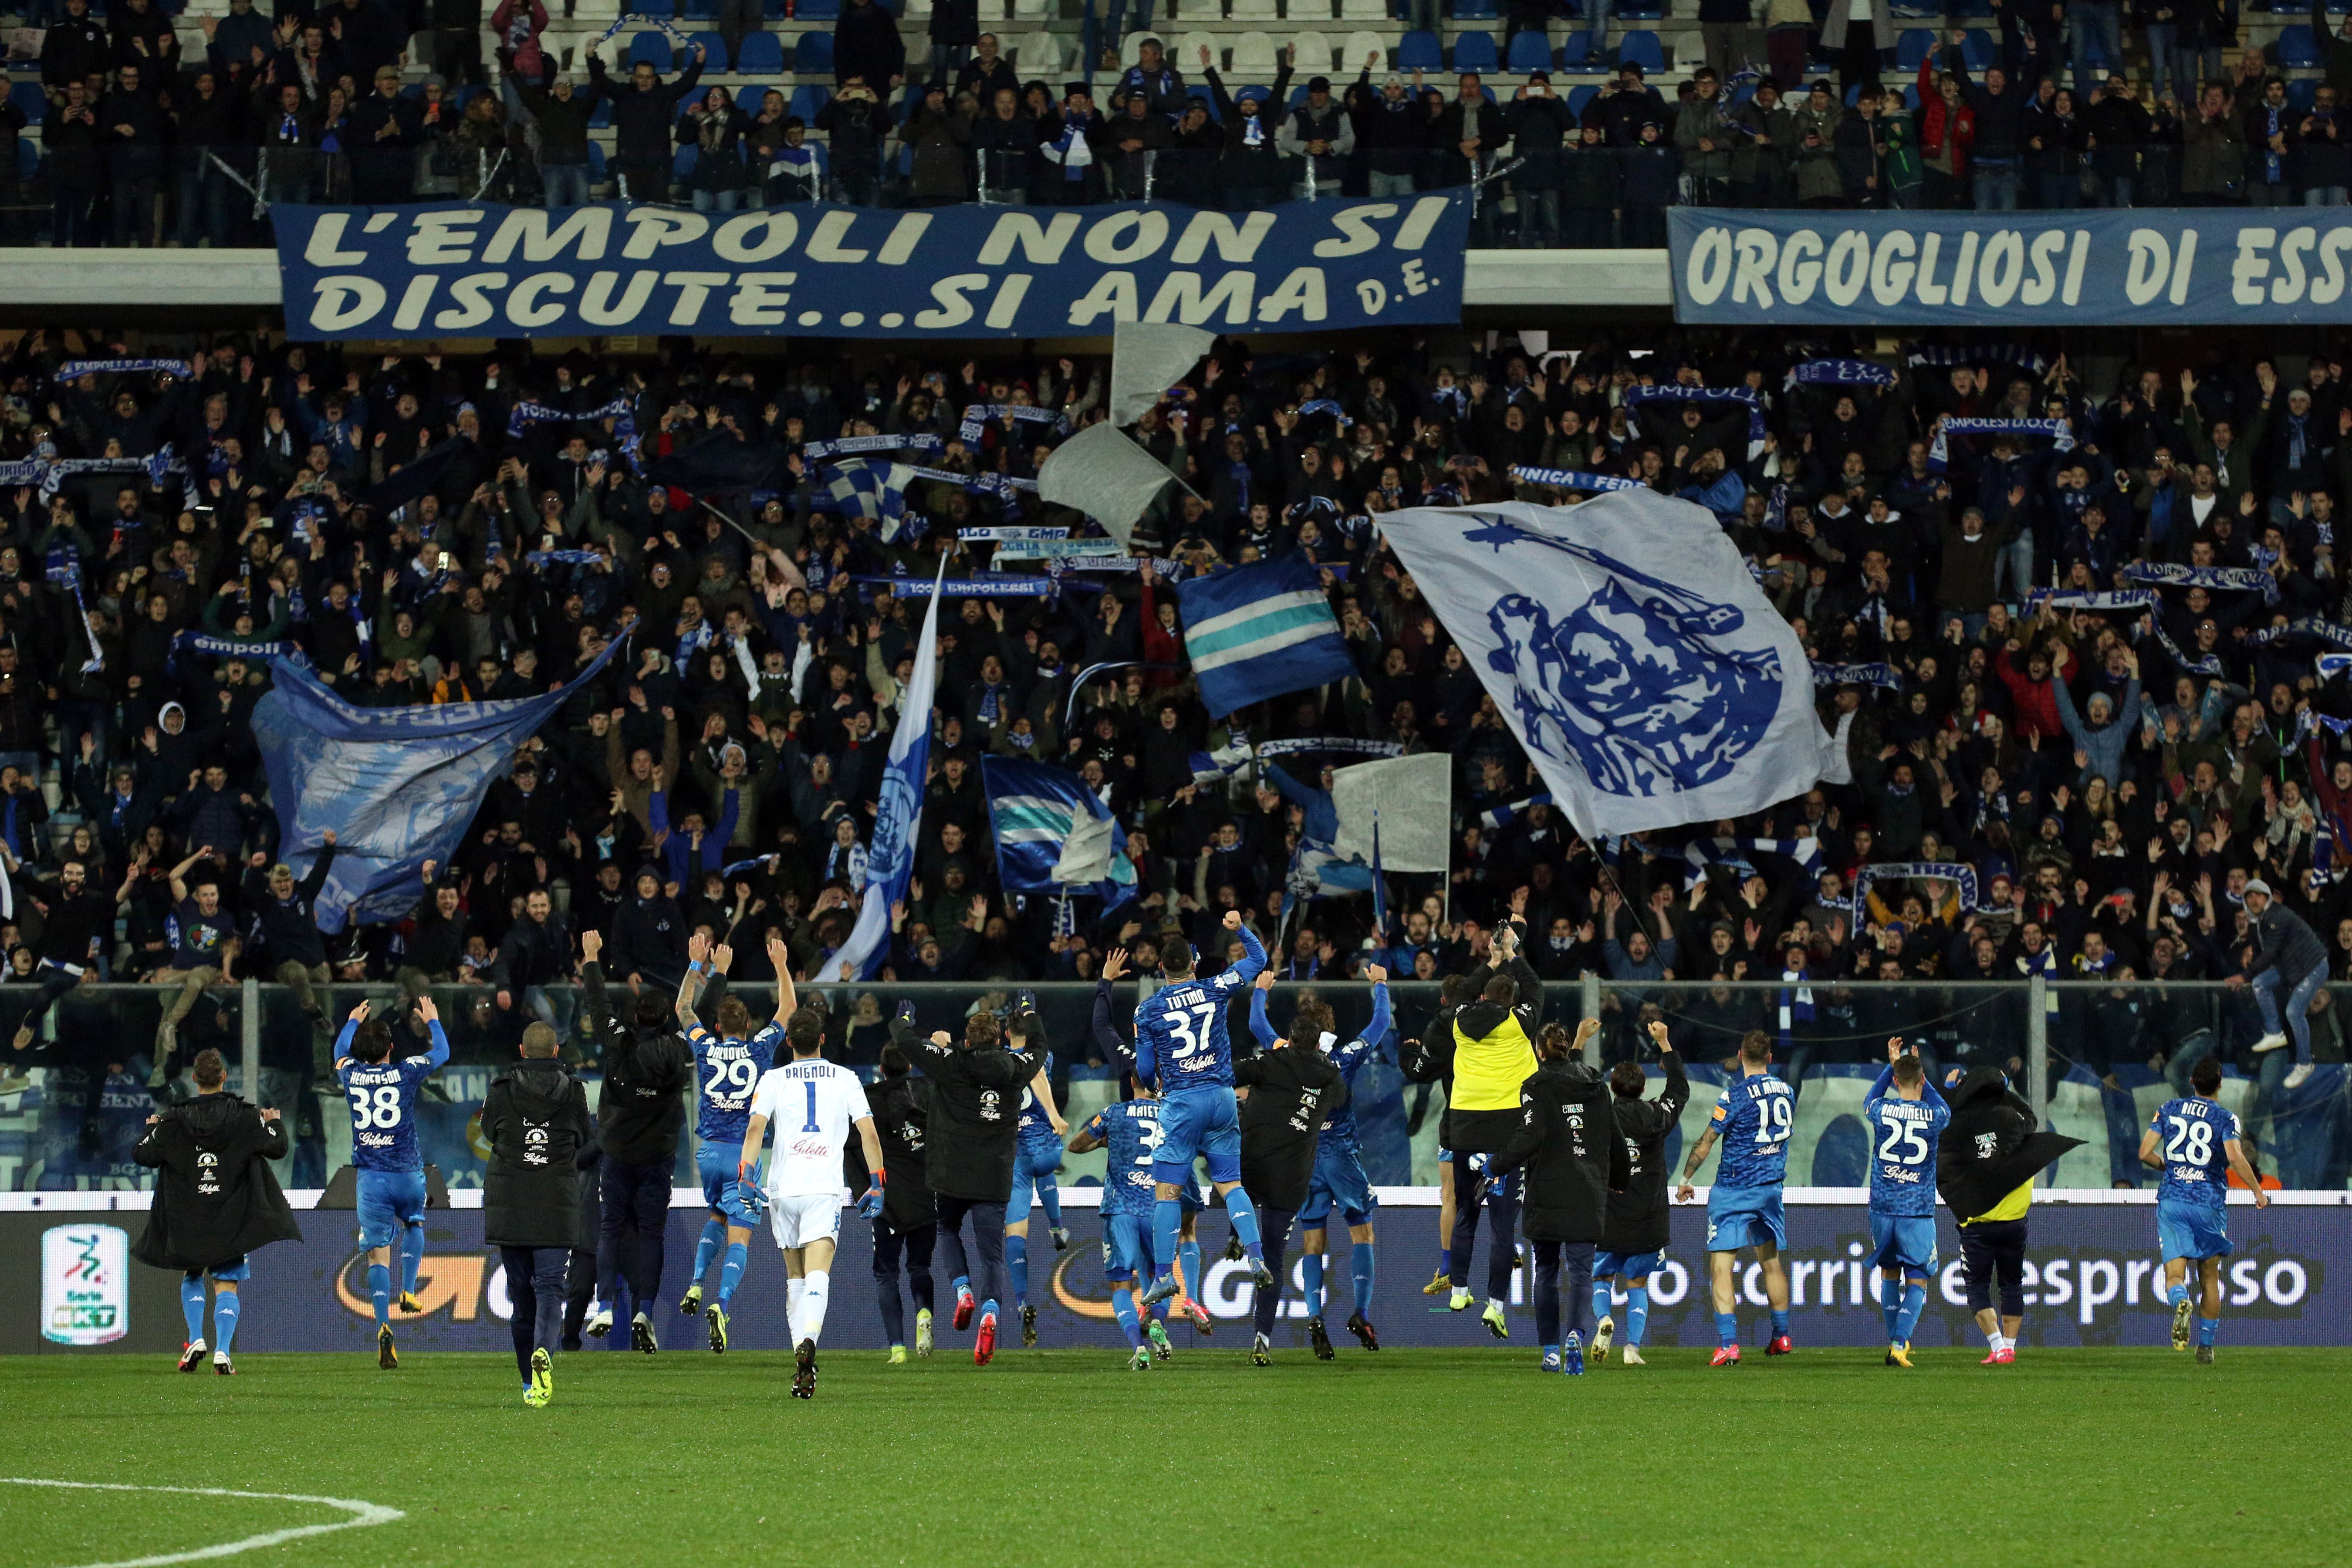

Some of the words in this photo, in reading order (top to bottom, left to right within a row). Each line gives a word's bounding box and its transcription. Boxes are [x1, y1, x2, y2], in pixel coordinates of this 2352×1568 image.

[304, 207, 933, 267] L'EMPOLI
[977, 210, 1277, 265] NON
[1313, 196, 1450, 257] SI
[1686, 227, 2090, 309] ORGOGLIOSI
[2126, 229, 2198, 305] DI
[2232, 227, 2352, 304] ESS
[1068, 267, 1327, 326] AMA
[194, 637, 278, 656] empoli
[1165, 988, 1206, 1010] TUTINO
[1162, 1001, 1217, 1059] 37
[1178, 1053, 1217, 1073] Giletti
[704, 1057, 758, 1099] 29
[785, 1066, 836, 1080] BRIGNOLI
[635, 1087, 658, 1096] Giletti
[1747, 1084, 1761, 1099] LA
[349, 1086, 402, 1130] 38
[801, 1081, 821, 1132] 1
[1881, 1103, 1934, 1122] BANDINELLI
[2180, 1102, 2209, 1119] RICCI
[1753, 1096, 1793, 1143] 19
[358, 1132, 395, 1146] Giletti
[1879, 1115, 1929, 1165] 25
[2165, 1115, 2213, 1166] 28
[523, 1152, 549, 1163] Giletti
[788, 1140, 829, 1159] Giletti
[1882, 1165, 1919, 1183] Giletti
[2173, 1166, 2206, 1181] Giletti
[198, 1183, 220, 1193] Giletti
